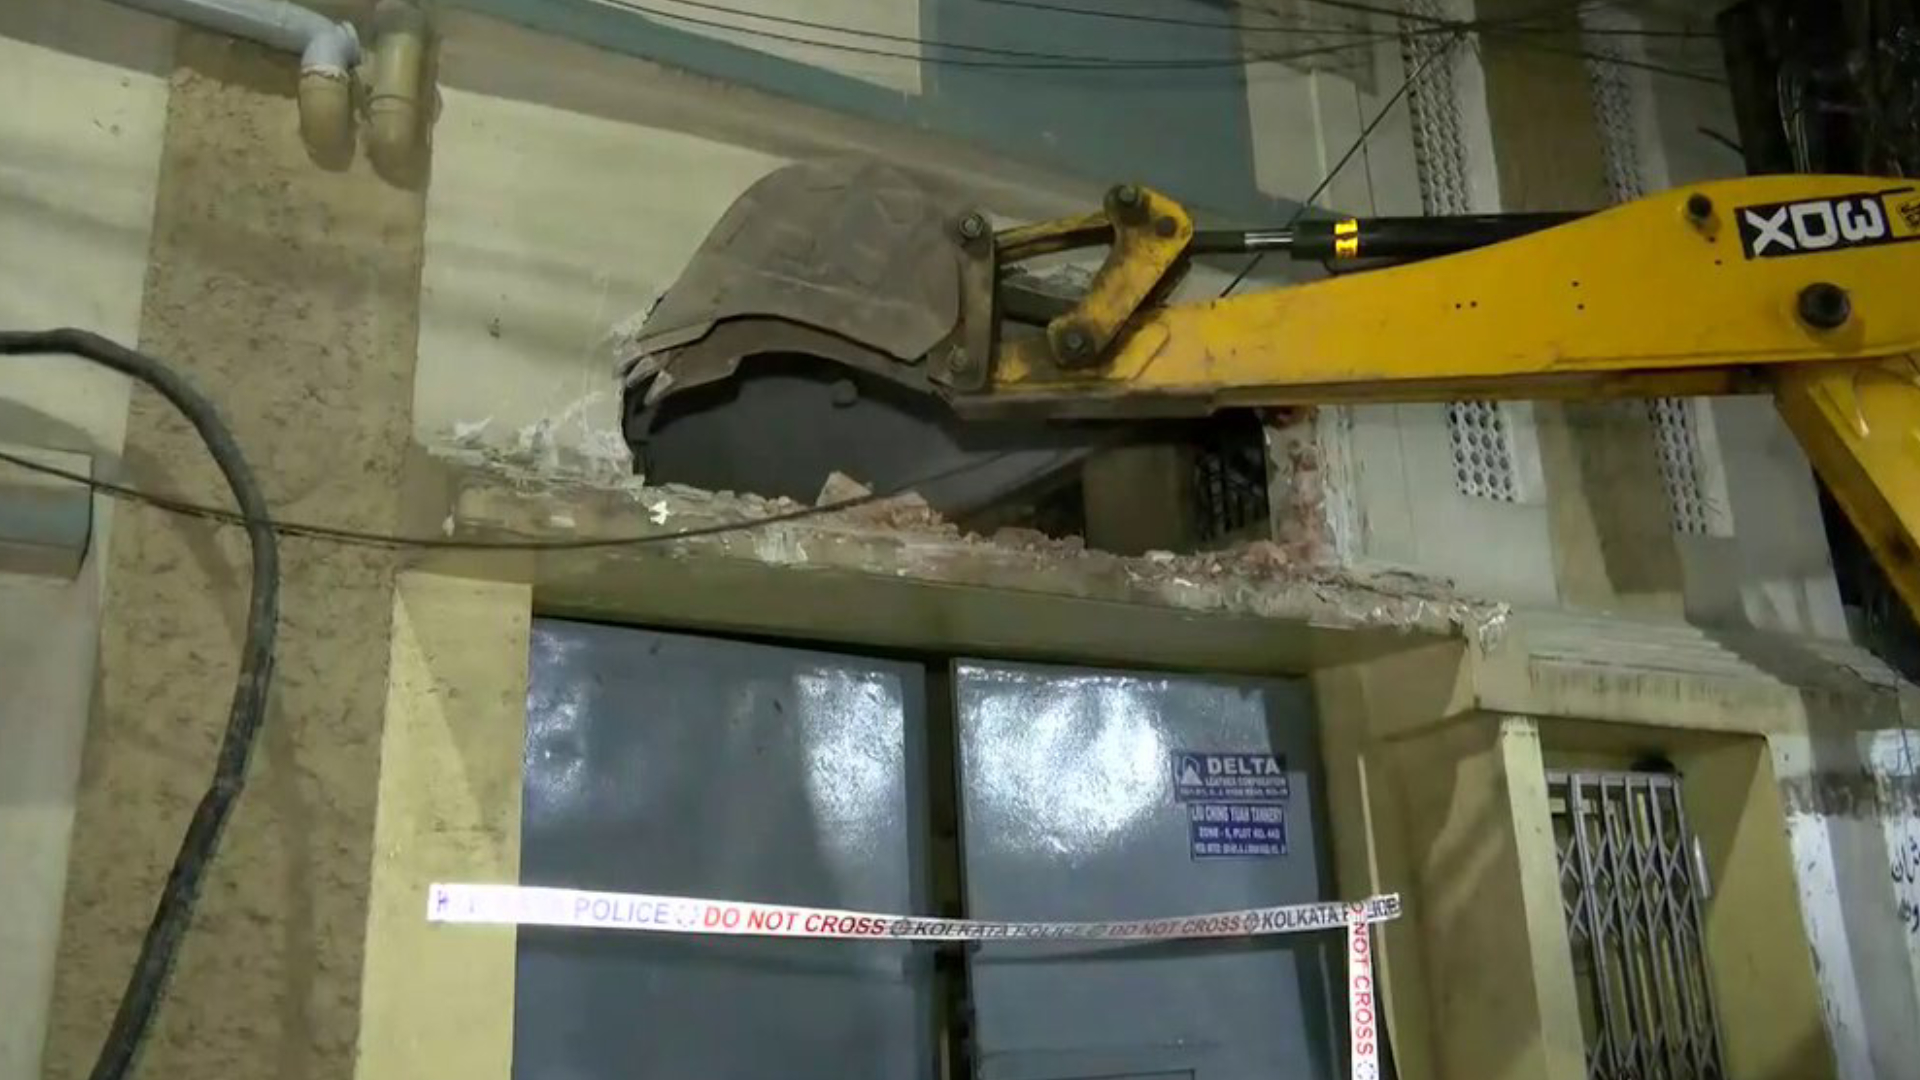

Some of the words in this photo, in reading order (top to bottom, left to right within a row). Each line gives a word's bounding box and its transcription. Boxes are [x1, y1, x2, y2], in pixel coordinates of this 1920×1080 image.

[1206, 757, 1281, 775] DELTA
[573, 896, 669, 923] POLICE
[704, 907, 741, 928] DO
[747, 911, 799, 931] NOT
[804, 914, 886, 935] CROSS
[1141, 920, 1178, 936] NOT
[1181, 914, 1240, 933] CROSS
[1260, 904, 1340, 930] KOLKATA
[1353, 920, 1369, 967] NOT
[1354, 975, 1374, 1056] CROSS
